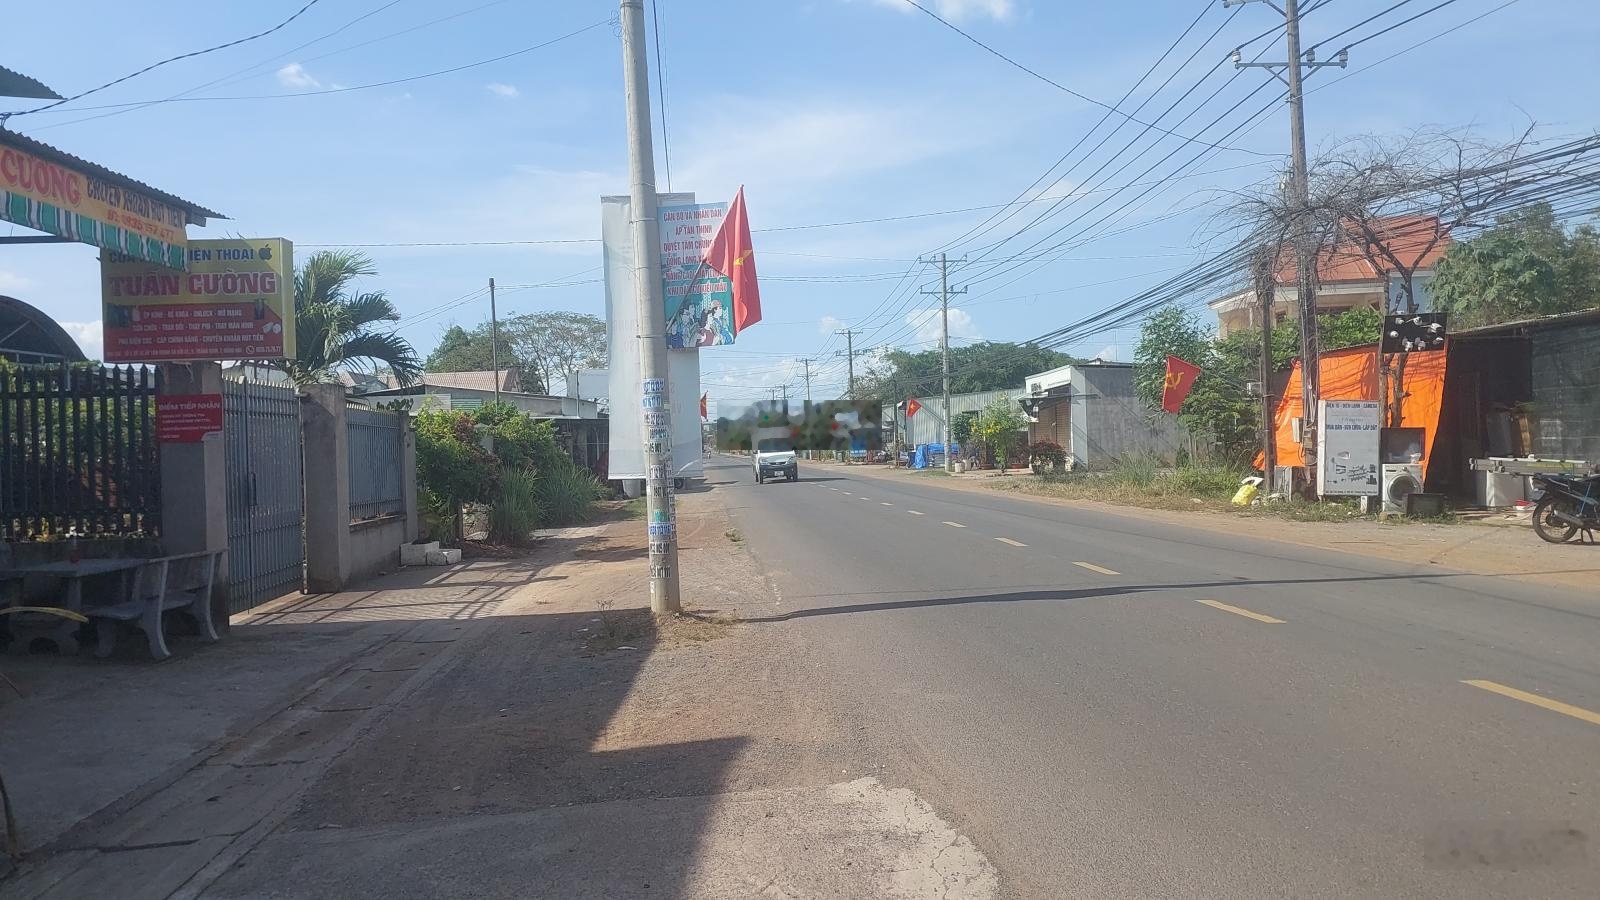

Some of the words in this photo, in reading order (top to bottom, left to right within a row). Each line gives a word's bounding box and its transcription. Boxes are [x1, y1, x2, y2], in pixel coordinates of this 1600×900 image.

[189, 249, 211, 264] IỆN
[216, 248, 253, 264] THOẠI
[108, 268, 180, 296] TUẤN
[188, 268, 277, 295] CƯỜNG
